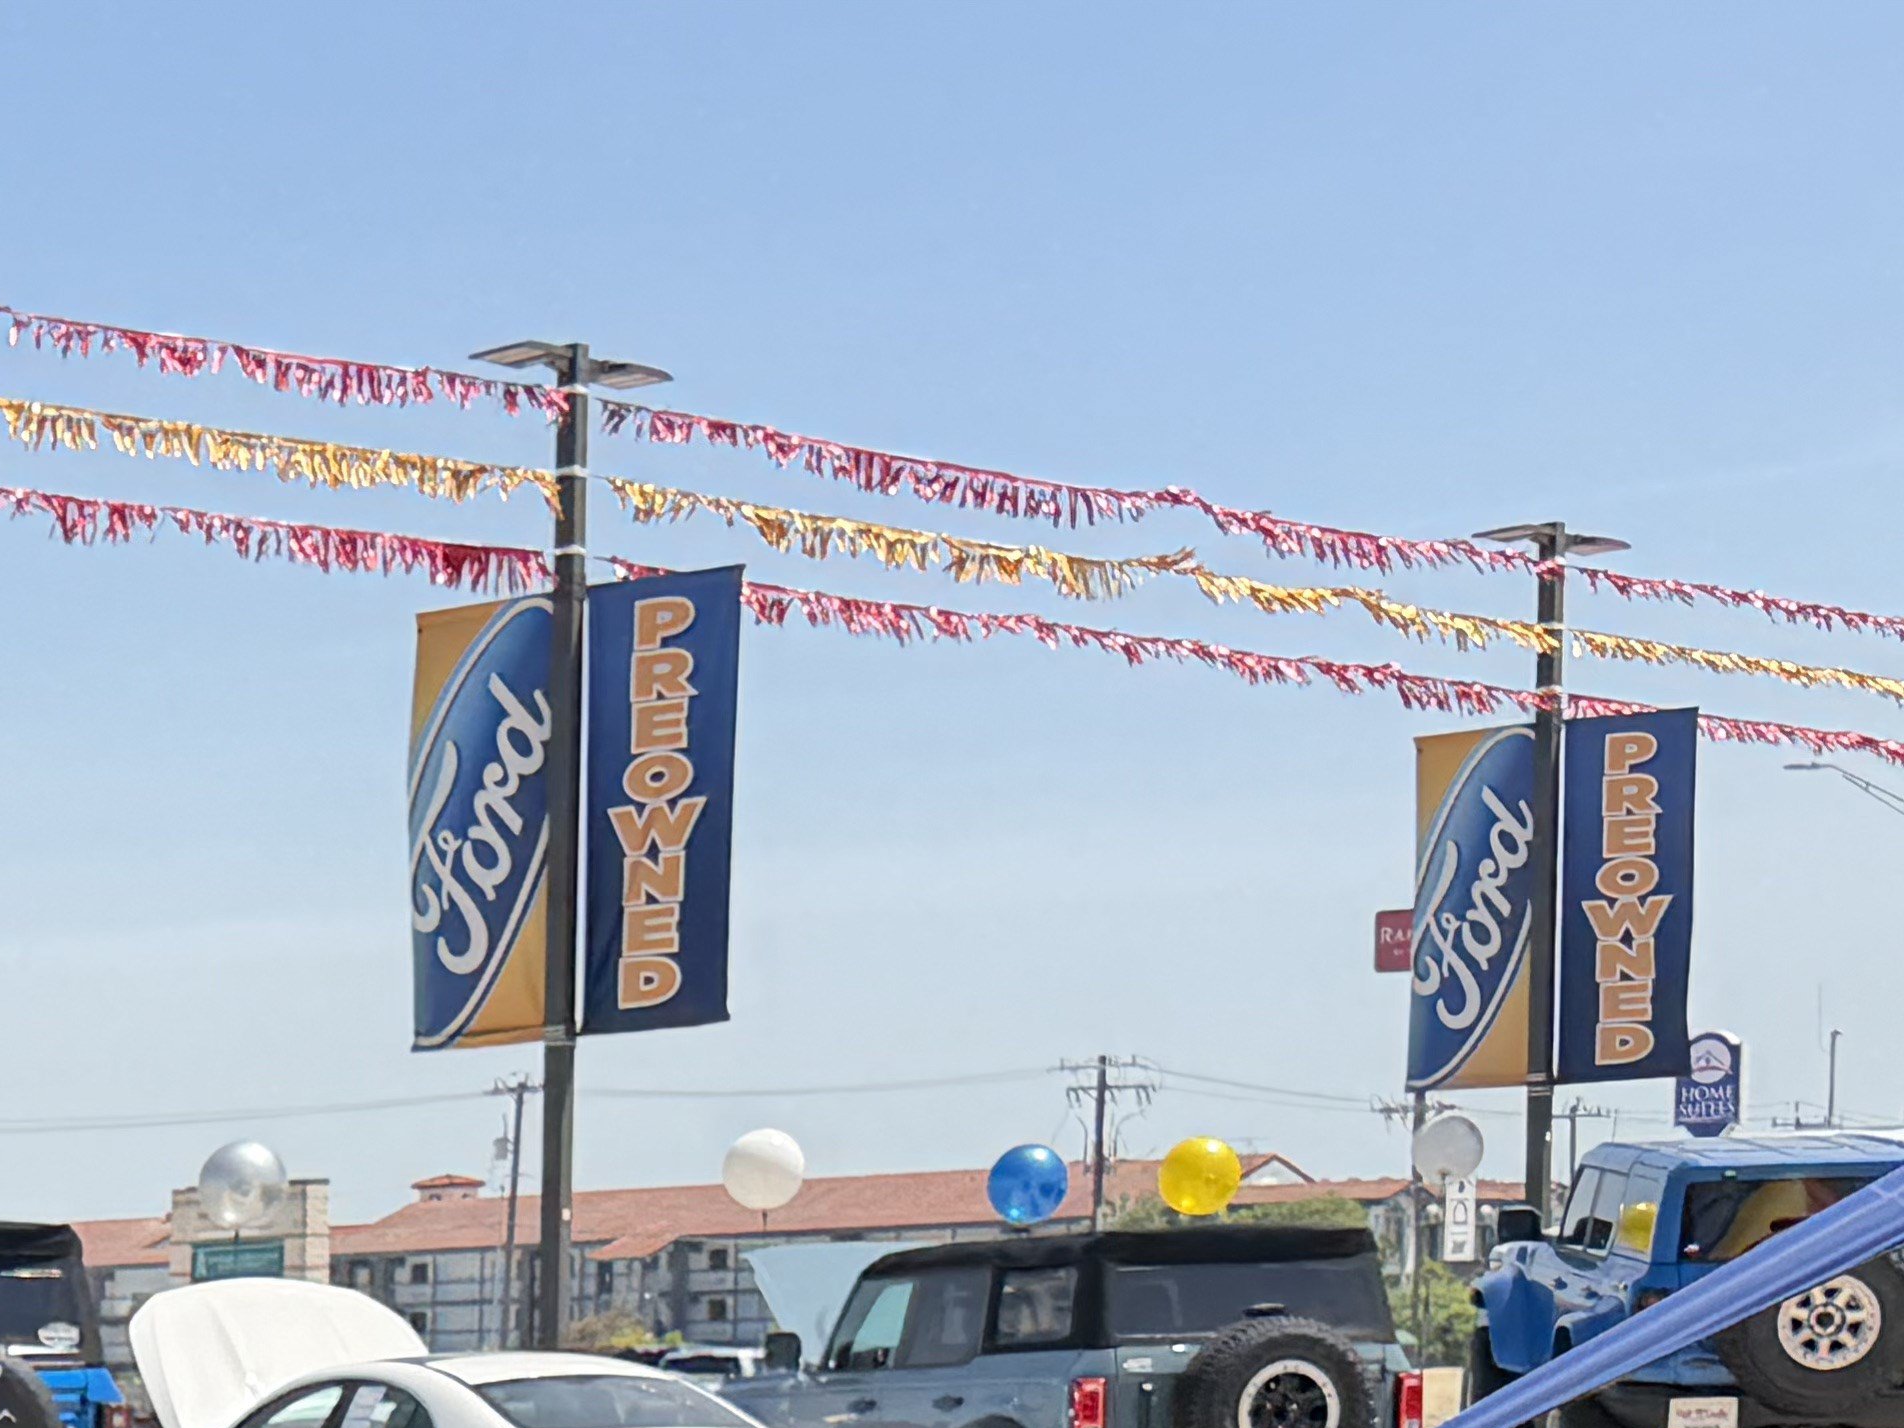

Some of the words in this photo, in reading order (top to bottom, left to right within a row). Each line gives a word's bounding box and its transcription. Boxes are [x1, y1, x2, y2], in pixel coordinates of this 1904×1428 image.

[411, 671, 553, 975] Ford
[607, 595, 708, 1010] PREOWNED
[1411, 783, 1534, 1030] Ford
[1581, 731, 1674, 1066] PREOWNED
